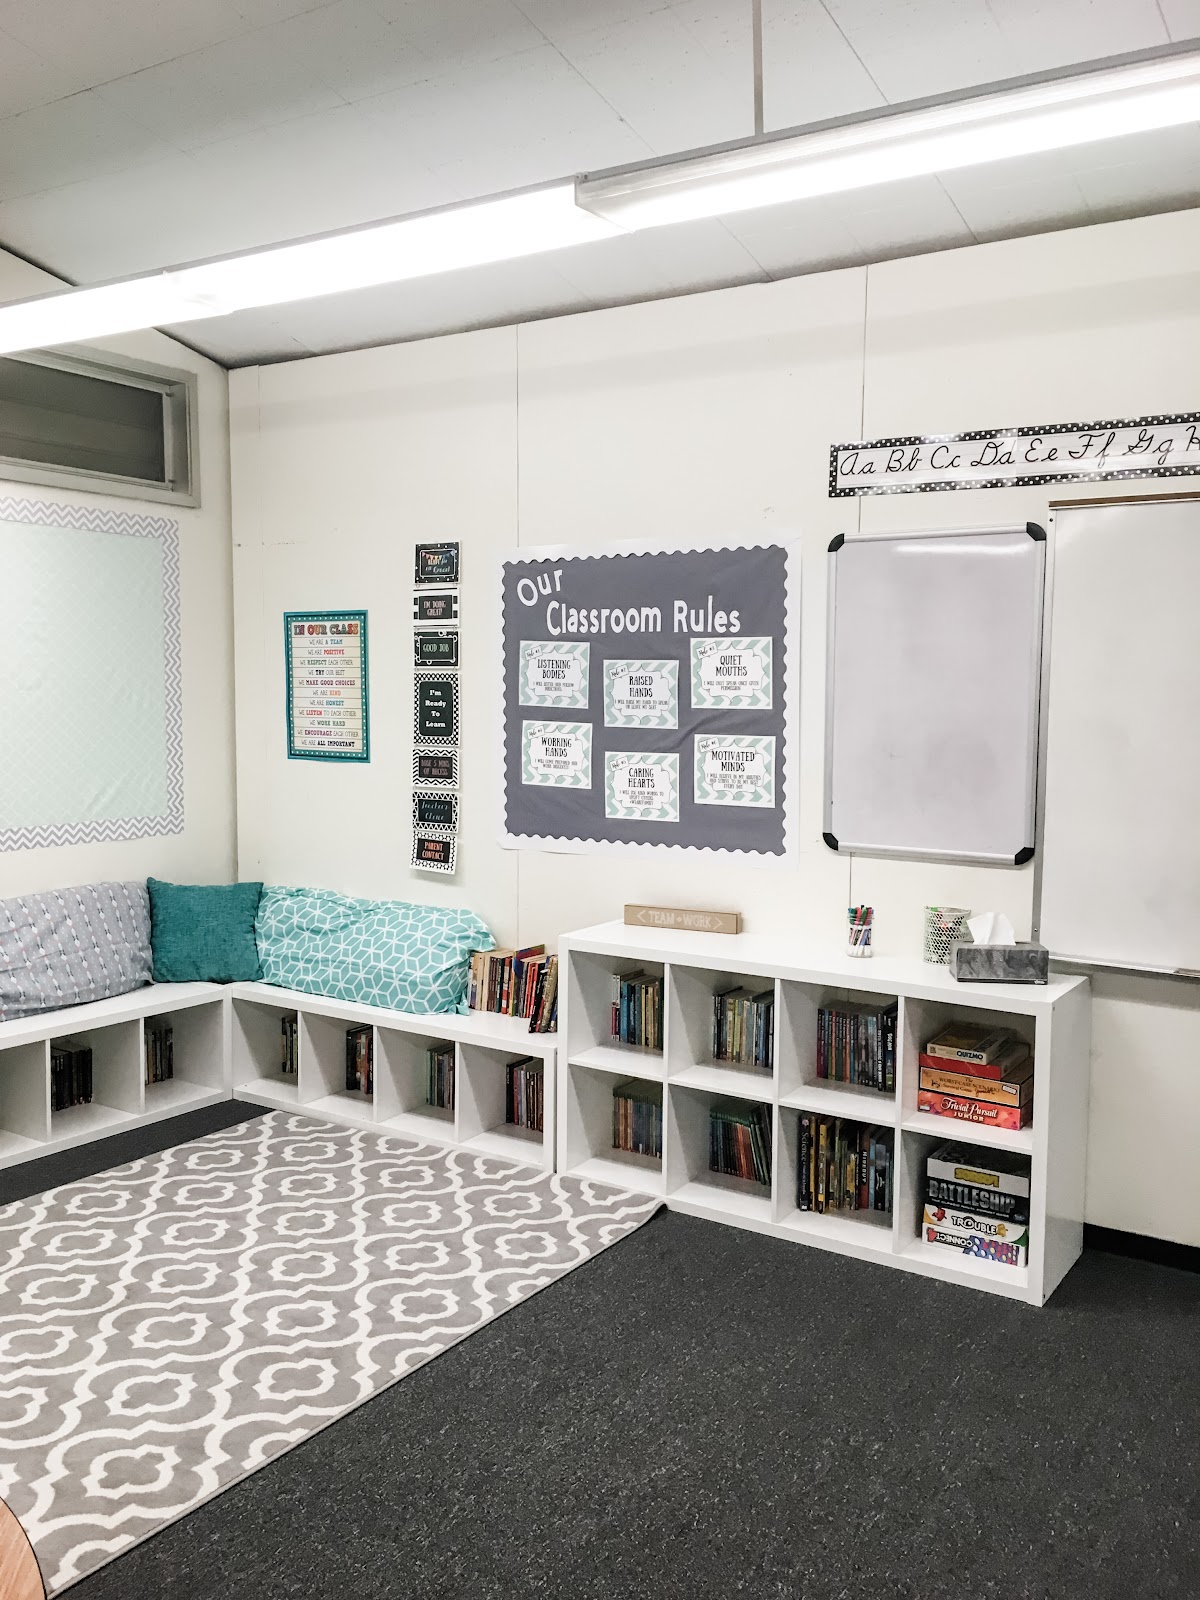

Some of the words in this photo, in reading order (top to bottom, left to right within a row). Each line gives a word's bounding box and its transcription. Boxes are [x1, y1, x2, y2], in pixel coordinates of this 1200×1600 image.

[840, 455, 876, 475] Aa
[885, 448, 922, 473] Bb
[930, 446, 960, 468] Cc
[1024, 438, 1058, 462] Ee
[1068, 431, 1116, 468] Ff
[1122, 429, 1174, 464] Gg
[517, 569, 563, 606] Our
[546, 600, 662, 635] Classroom
[673, 595, 741, 633] Rules
[308, 624, 327, 635] OUR
[329, 624, 359, 635] CLASS
[422, 644, 437, 652] GOOD
[538, 659, 570, 669] LISTENING
[720, 655, 742, 666] QUIET
[542, 670, 565, 679] BODIES
[716, 666, 747, 676] MOUTHS
[629, 676, 653, 685] RAISED
[630, 688, 652, 697] HANDS
[425, 700, 446, 708] Ready
[542, 737, 572, 747] WORKING
[546, 747, 567, 757] HANDS
[712, 751, 755, 761] MOTIVATED
[721, 762, 745, 772] MINDS
[629, 768, 654, 777] CARING
[628, 778, 655, 788] HEARTS
[424, 842, 443, 851] PARENT
[422, 850, 444, 860] CONTACT
[648, 910, 674, 924] TEAM
[682, 914, 711, 928] WORK
[957, 1050, 983, 1060] QUIZMO
[941, 1098, 968, 1112] Trivial
[968, 1104, 998, 1118] Pursuit
[954, 1112, 984, 1122] JUNIOR
[929, 1180, 1016, 1213] BATTLESHIP
[951, 1216, 996, 1234] TROUBLE
[927, 1227, 937, 1242] 4
[936, 1232, 973, 1247] CONNECT
